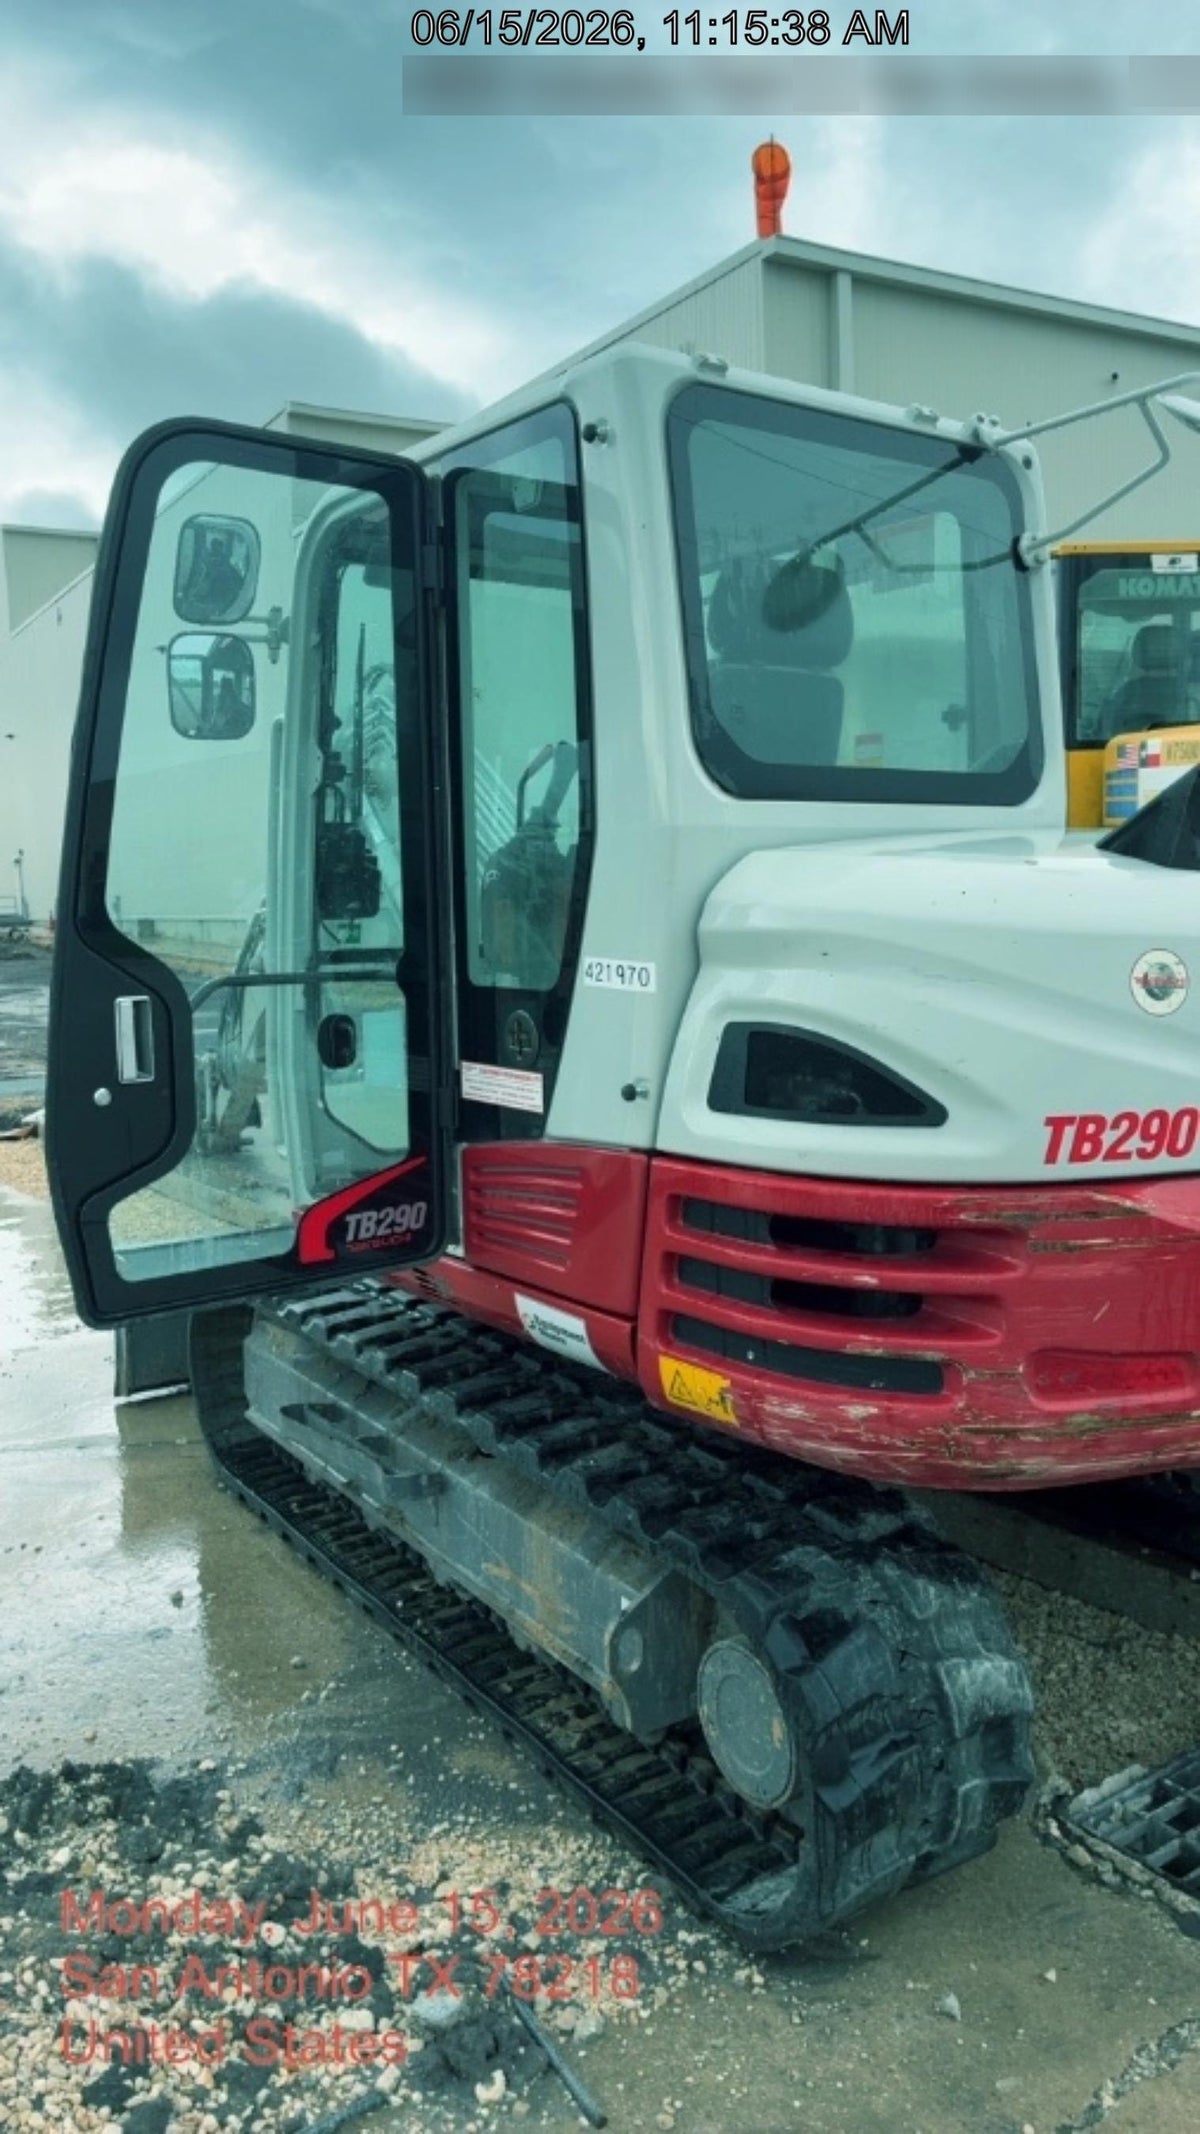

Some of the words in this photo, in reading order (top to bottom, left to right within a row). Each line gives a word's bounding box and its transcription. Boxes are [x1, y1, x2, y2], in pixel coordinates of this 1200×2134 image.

[585, 961, 651, 987] 421970
[1043, 1107, 1199, 1165] TB290
[345, 1201, 428, 1243] TB290
